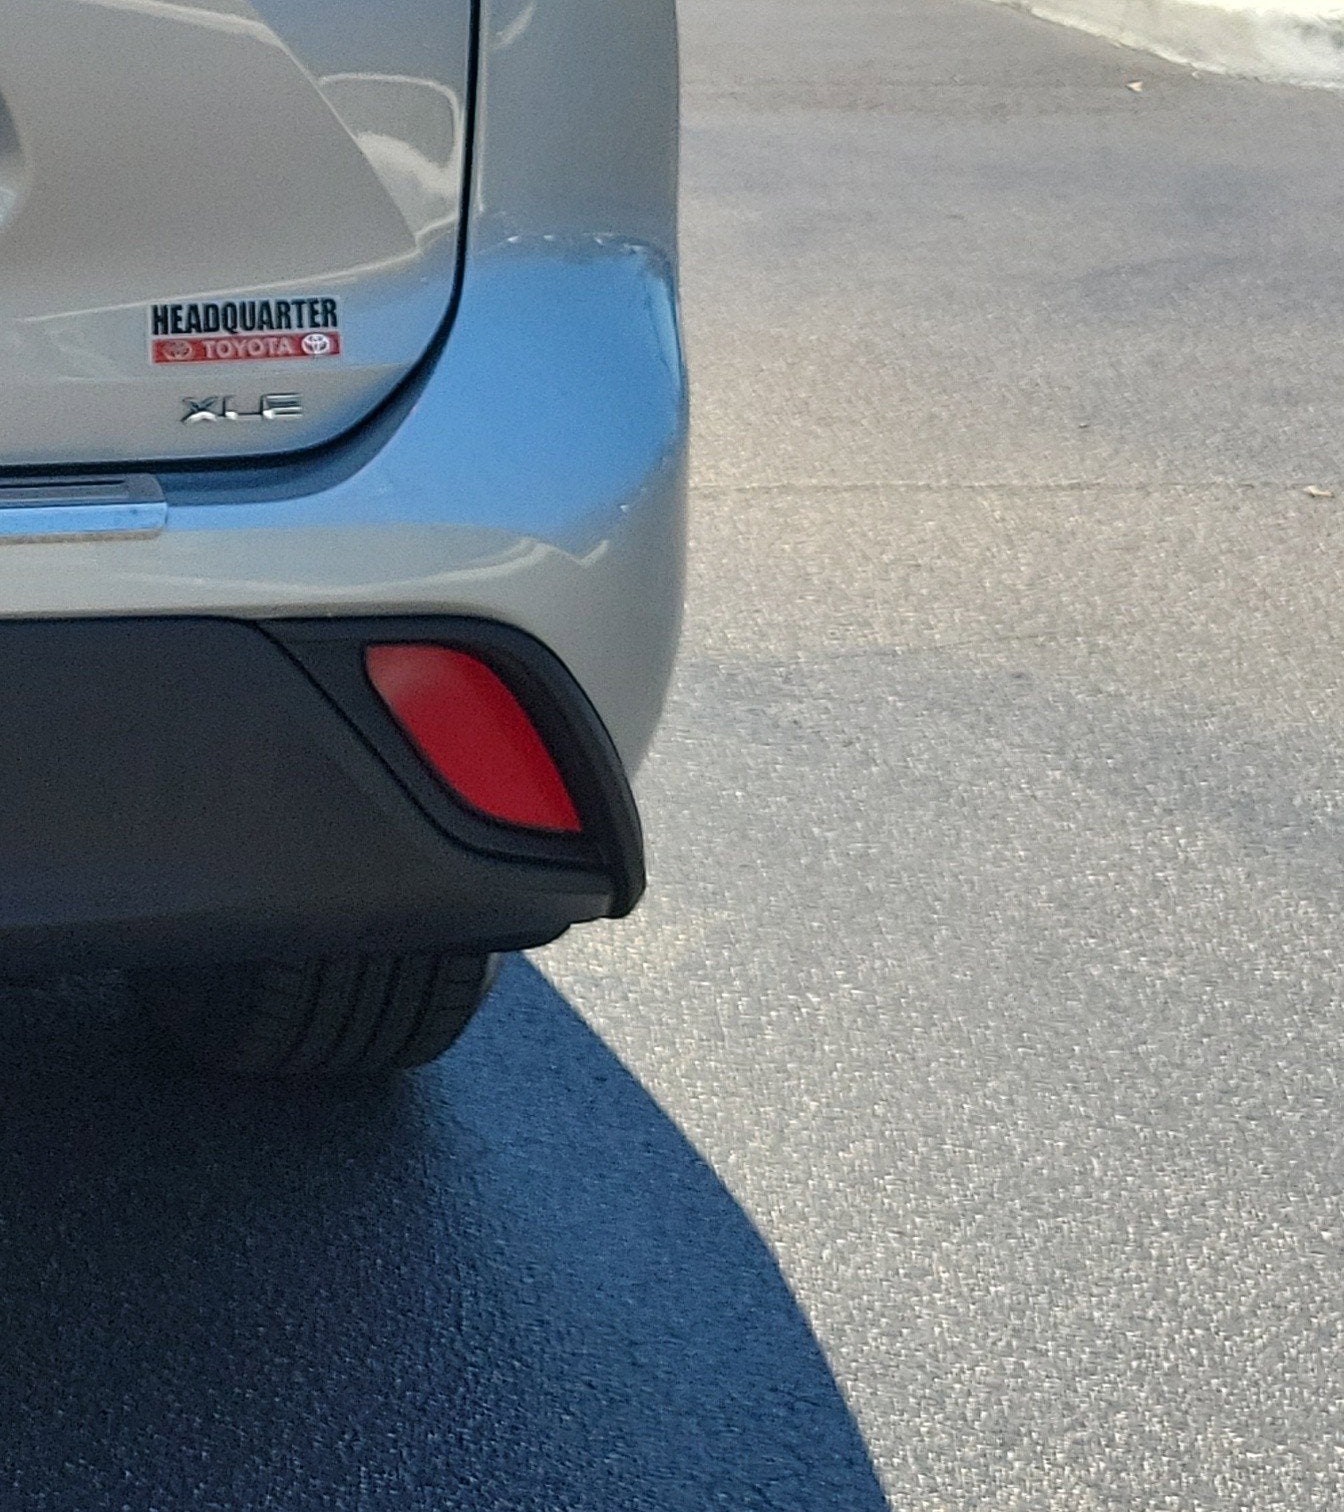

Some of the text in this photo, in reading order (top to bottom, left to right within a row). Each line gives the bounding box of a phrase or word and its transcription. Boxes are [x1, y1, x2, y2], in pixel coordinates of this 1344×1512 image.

[151, 297, 339, 335] HEADQUARTER
[203, 337, 295, 359] TOYOTA
[180, 392, 303, 424] XLE
